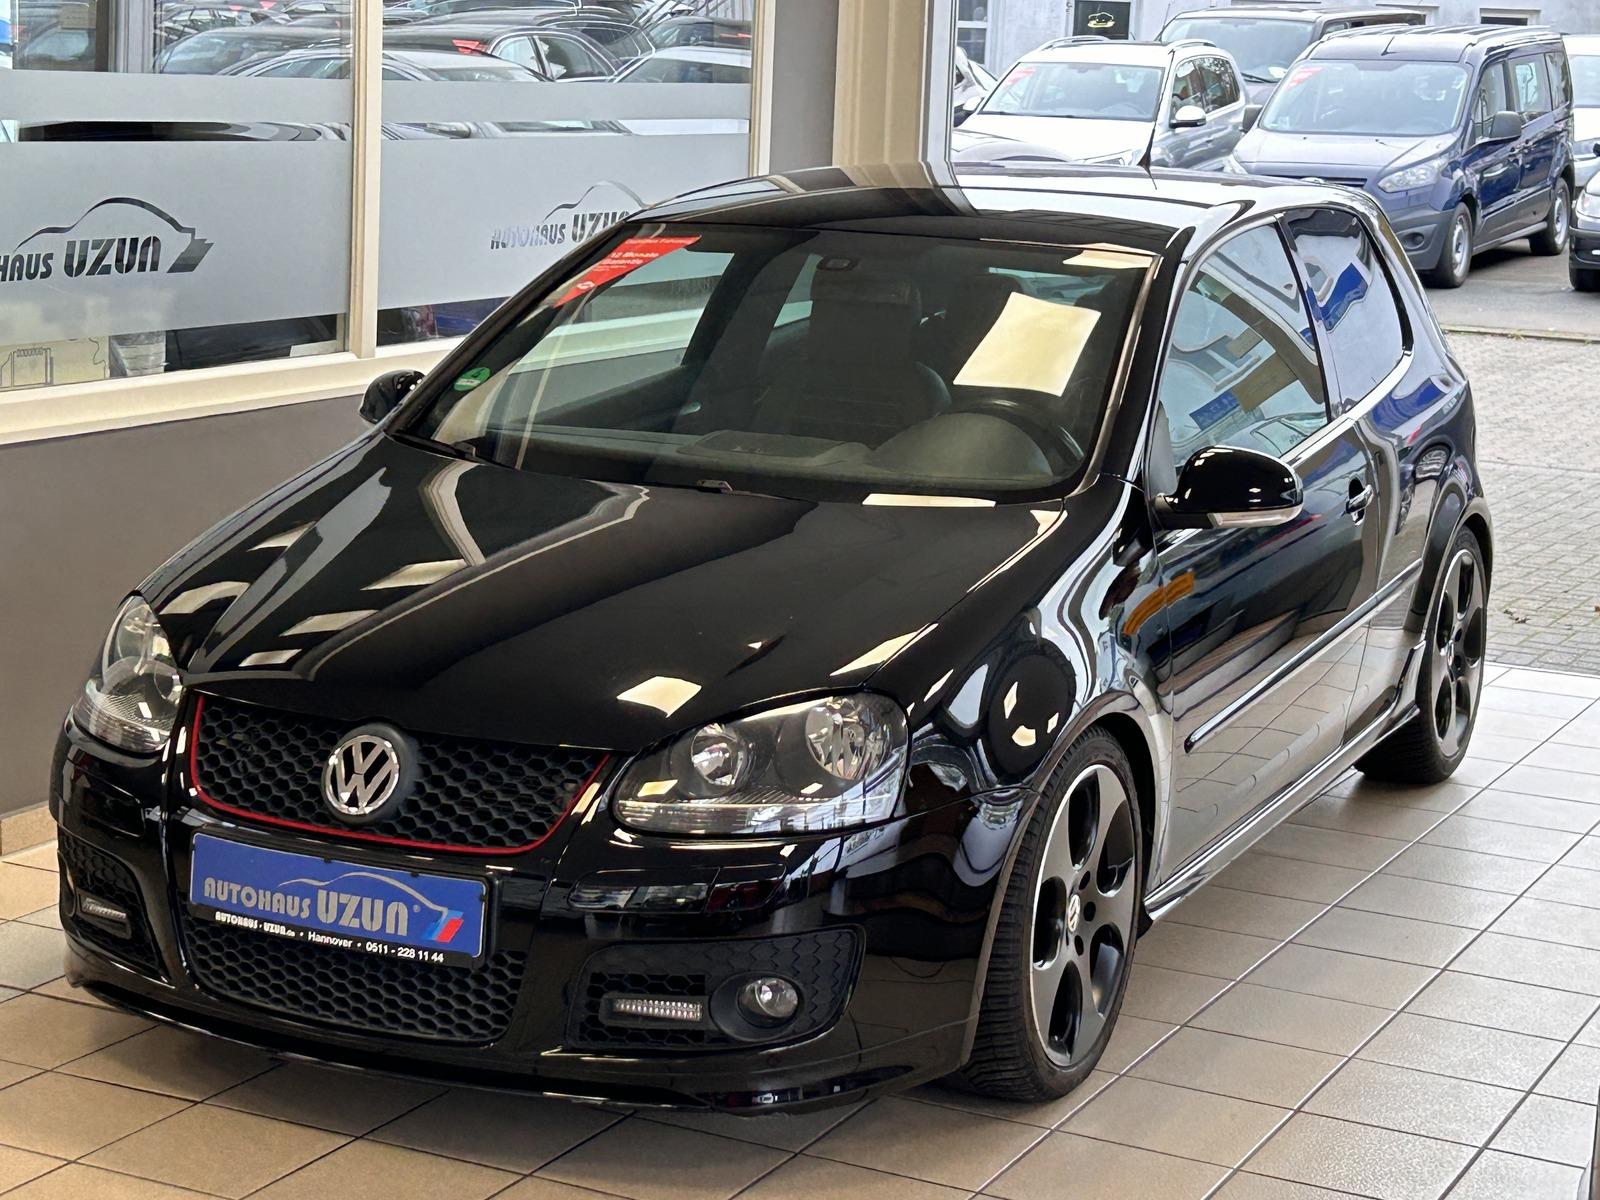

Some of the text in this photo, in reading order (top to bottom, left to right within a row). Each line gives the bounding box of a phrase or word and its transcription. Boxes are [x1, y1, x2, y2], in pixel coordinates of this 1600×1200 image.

[63, 235, 162, 278] UZUN
[204, 877, 409, 937] AUTOHAUS UZUN
[308, 931, 353, 948] Hannover
[365, 941, 388, 955] 0511
[397, 947, 416, 958] 228
[418, 951, 428, 961] 11
[431, 952, 444, 963] 44
